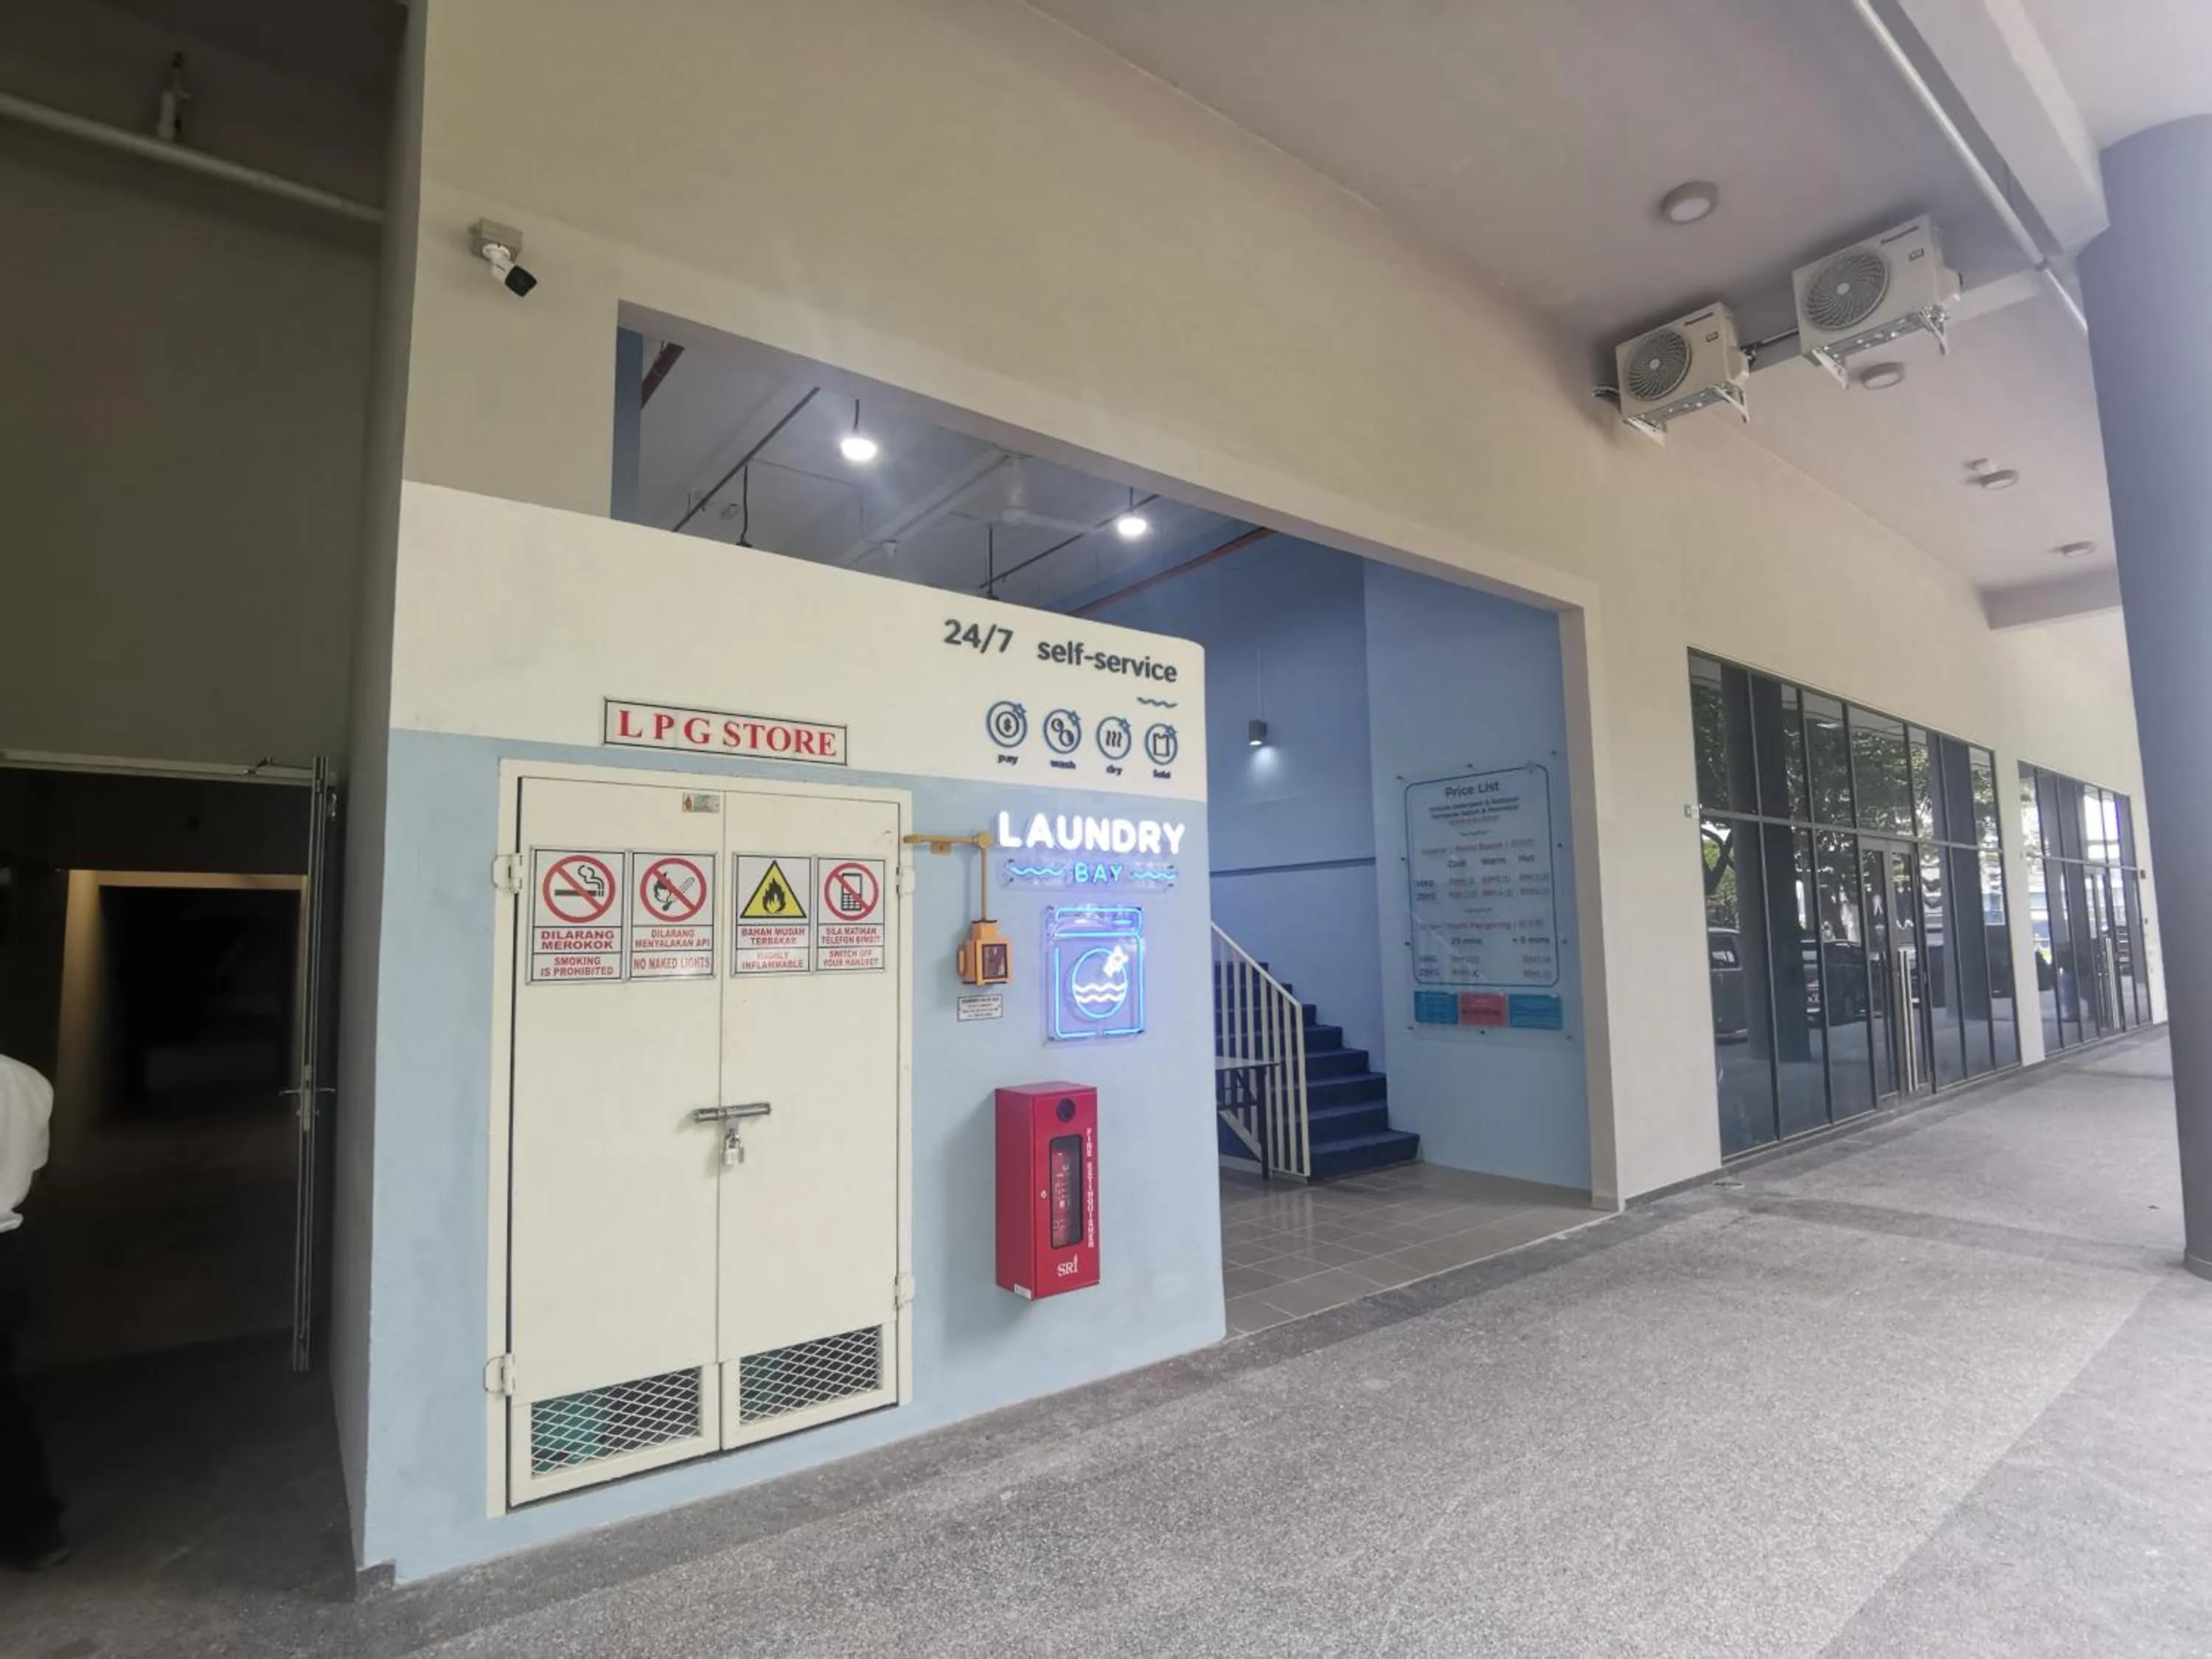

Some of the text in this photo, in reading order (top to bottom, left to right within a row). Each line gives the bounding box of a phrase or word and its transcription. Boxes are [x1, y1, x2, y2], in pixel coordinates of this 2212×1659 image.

[943, 619, 1178, 683] 24/7 self-service
[723, 720, 838, 757] STORE
[998, 754, 1018, 765] pay
[1445, 781, 1500, 798] Price List
[999, 811, 1185, 855] LAUNDRY
[1074, 862, 1123, 883] BAY
[540, 930, 614, 940] DILARANG
[650, 929, 695, 938] DILARANG
[741, 927, 805, 936] BAHAN MUDAH
[825, 927, 877, 935] SILA MATIKAN
[541, 940, 613, 950] MEROKOK
[635, 938, 710, 948] MENYALAKAN API
[822, 936, 854, 945] TELEFON
[828, 949, 873, 958] SWITCH OFF
[554, 956, 601, 966] SMOKING
[633, 956, 710, 970] NO NAKED LIGHTS
[742, 960, 803, 970] INFLAMMABLE
[844, 958, 878, 966] HANDSET
[540, 967, 614, 976] IS PROHIBITED
